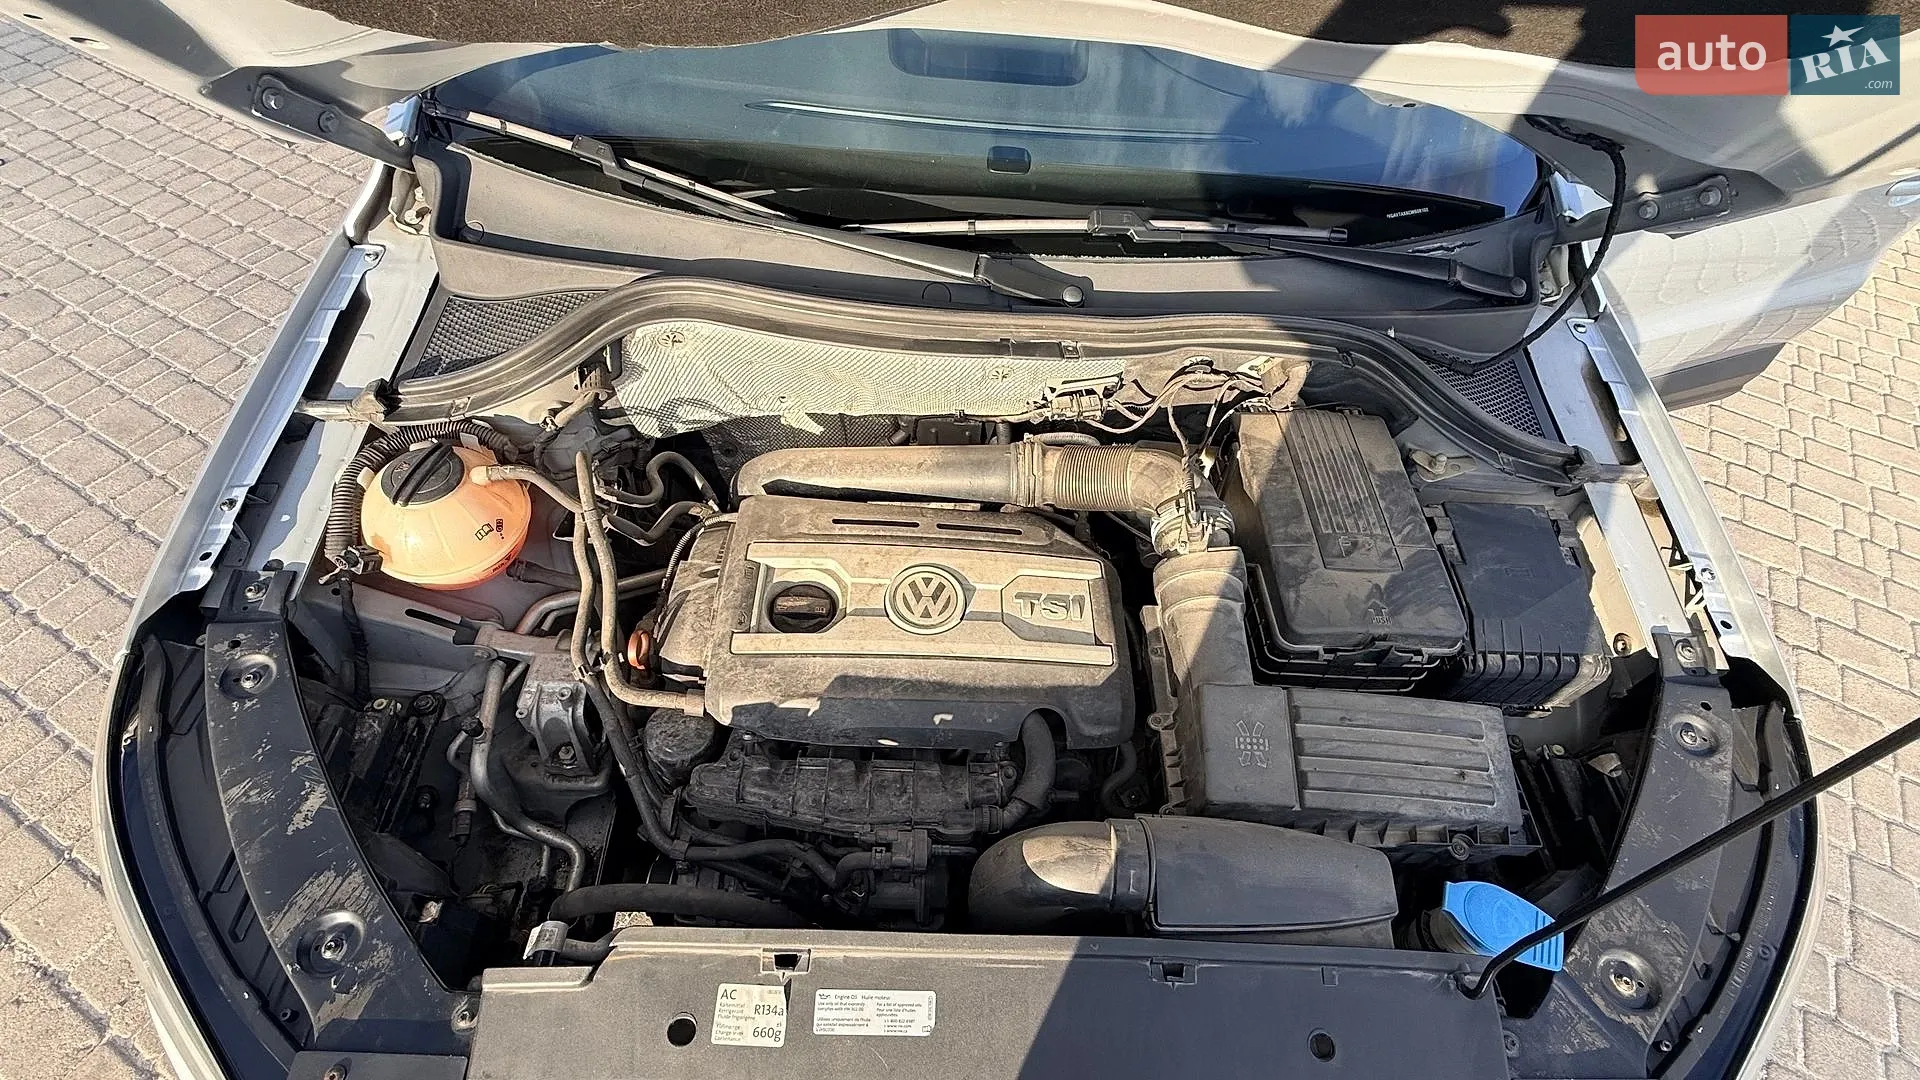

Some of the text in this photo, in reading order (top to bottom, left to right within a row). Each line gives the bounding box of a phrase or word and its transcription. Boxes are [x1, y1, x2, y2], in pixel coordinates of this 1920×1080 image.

[1013, 592, 1087, 621] TSI
[720, 988, 737, 1000] AC
[754, 1003, 784, 1016] R134a
[752, 1026, 782, 1042] 660g
